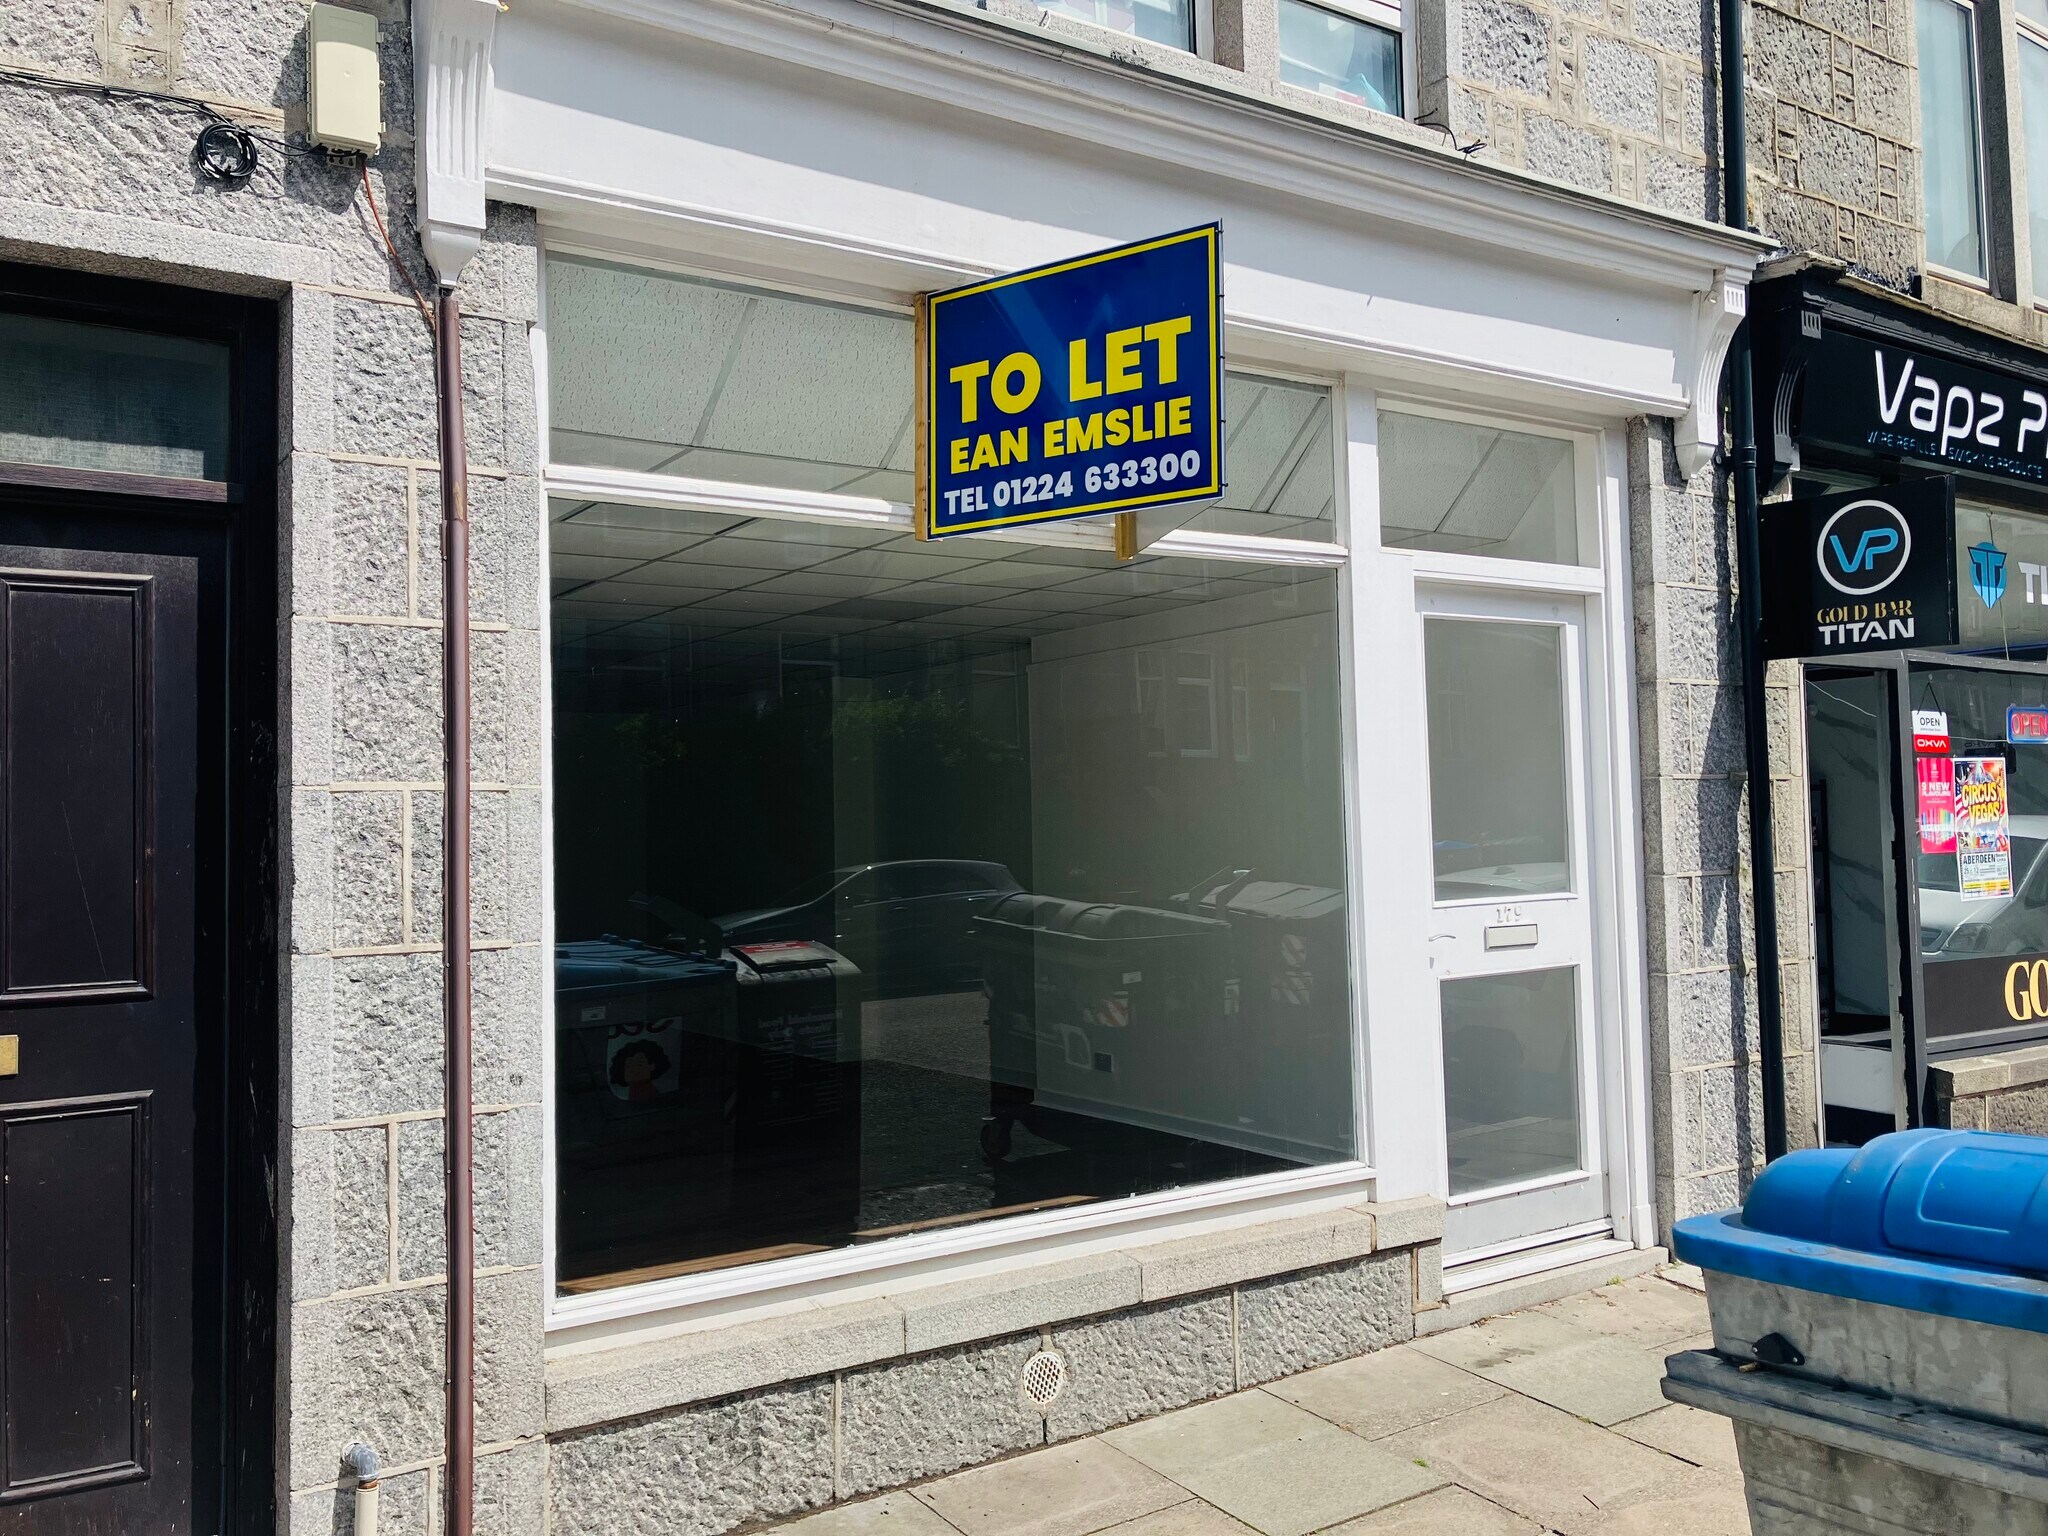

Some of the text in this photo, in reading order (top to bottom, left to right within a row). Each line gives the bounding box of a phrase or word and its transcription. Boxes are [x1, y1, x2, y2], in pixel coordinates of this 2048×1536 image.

[949, 315, 1192, 424] TO LET
[1873, 348, 2006, 456] Vapz
[950, 396, 1192, 475] EAN EMSLIE
[944, 449, 1201, 515] TEL 01224 633300
[1816, 599, 1913, 624] GOLD BAR
[1817, 617, 1915, 646] TITAN
[1919, 717, 1941, 727] OPEN
[2011, 713, 2048, 737] OPEN
[1917, 738, 1947, 749] OXVA
[1928, 781, 1950, 791] NEW
[1961, 781, 1997, 807] CIRCUS
[1967, 801, 2000, 826] VEGAS
[1963, 853, 1996, 865] ABERDEEN
[2004, 959, 2048, 1021] GO
